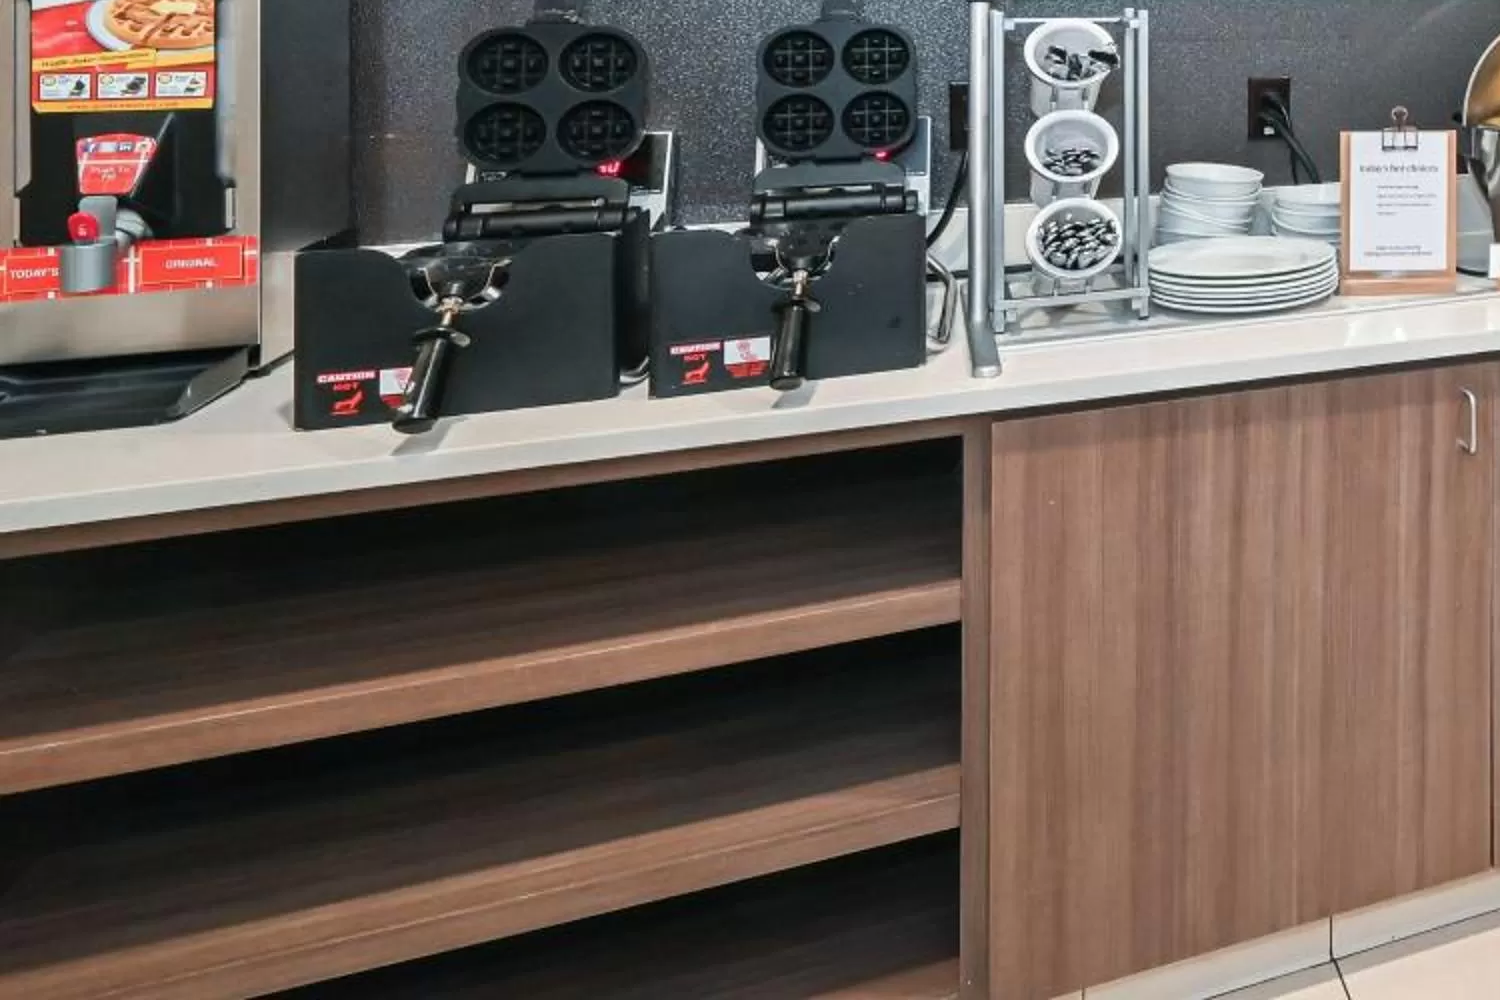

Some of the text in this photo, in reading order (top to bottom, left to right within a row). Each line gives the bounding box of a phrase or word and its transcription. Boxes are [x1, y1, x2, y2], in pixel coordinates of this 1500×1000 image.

[165, 256, 219, 270] ORIGINAL
[9, 267, 59, 280] TODAY'S
[670, 342, 721, 355] CAUTION
[316, 370, 376, 384] CAUTION
